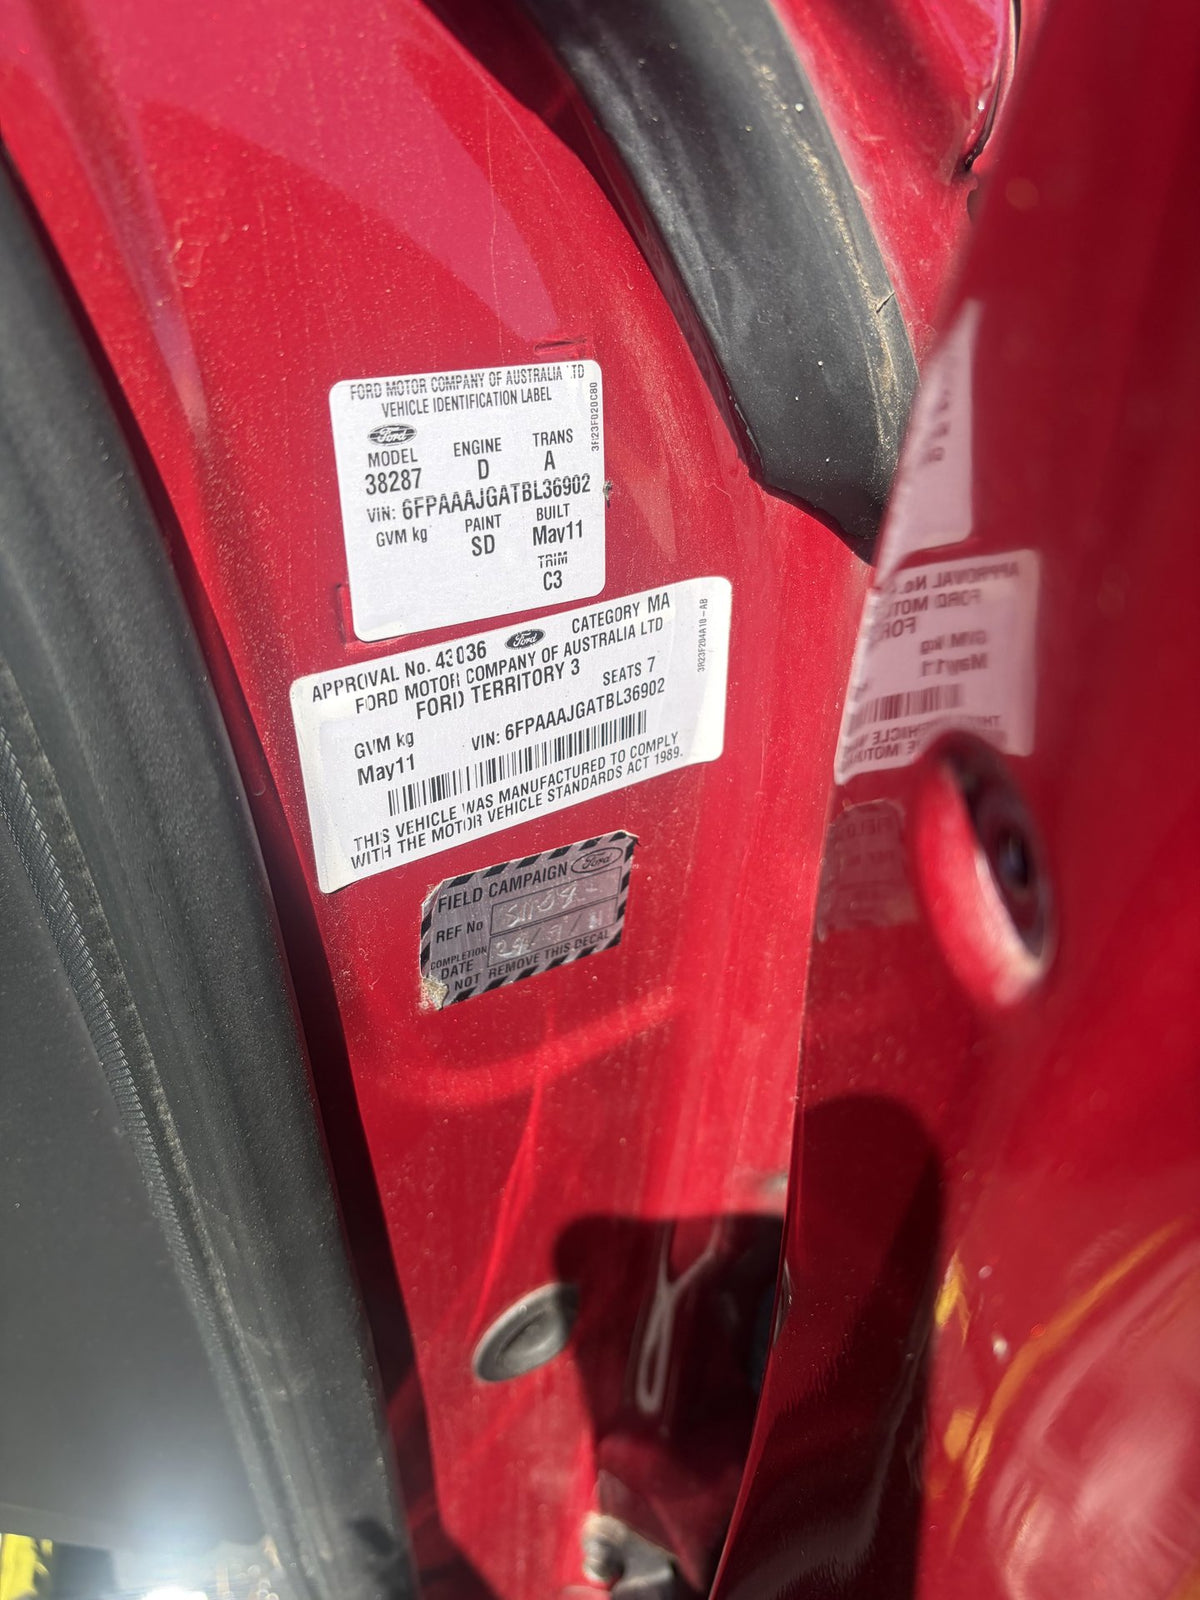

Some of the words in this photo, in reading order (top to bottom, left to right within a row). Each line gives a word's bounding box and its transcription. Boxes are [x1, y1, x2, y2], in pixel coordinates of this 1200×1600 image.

[350, 382, 382, 400] FORD
[386, 378, 427, 397] MOTOR
[431, 372, 484, 393] COMPANY
[489, 371, 502, 387] OF
[506, 365, 563, 386] AUSTRALIA
[566, 364, 585, 380] TD
[382, 398, 429, 418] VEHICLE
[433, 389, 518, 413] IDENTIFICATION
[521, 386, 552, 404] LABEL
[453, 437, 502, 457] ENGINE
[532, 428, 573, 447] TRANS
[368, 447, 418, 468] MODEL
[478, 458, 490, 480] D
[544, 450, 556, 471] A
[365, 467, 422, 496] 38287
[366, 506, 396, 523] VIN:
[402, 472, 591, 520] 6FPAAAJGATBL36902
[537, 503, 570, 521] BUILT
[376, 529, 407, 548] GVM
[412, 526, 428, 543] kg
[465, 514, 502, 533] PAINT
[471, 534, 495, 557] SD
[537, 551, 568, 568] TRIM
[543, 570, 563, 591] C3
[572, 601, 641, 634] CATEGORY
[647, 592, 670, 614] MA
[312, 666, 400, 703] APPROVAL
[405, 661, 431, 678] No.
[435, 640, 487, 669] 43036
[355, 688, 398, 714] FORD
[404, 672, 460, 702] MOTOR
[466, 651, 536, 684] COMPANY
[541, 645, 559, 663] OF
[564, 624, 636, 658] AUSTRALIA
[640, 617, 663, 636] LTD
[602, 662, 642, 686] SEATS
[647, 656, 656, 673] 7
[416, 690, 465, 720] FORD
[471, 661, 565, 704] TERRITORY
[571, 658, 580, 676] 3
[472, 731, 500, 751] VIN:
[505, 677, 665, 741] 6FPAAAJGATBL36902
[354, 735, 391, 760] GVM
[396, 731, 414, 748] kg
[357, 753, 415, 786] May11
[354, 828, 390, 852] THIS
[396, 805, 457, 838] VEHICLE
[462, 793, 494, 815] WAS
[499, 756, 606, 804] MANUFACTURED
[610, 749, 626, 765] TO
[630, 731, 679, 759] COMPLY
[351, 844, 391, 870] WITH
[398, 833, 426, 854] THE
[431, 813, 482, 843] MOTOR
[487, 792, 542, 823] VEHICLE
[547, 765, 622, 803] STANDARDS
[627, 756, 650, 776] ACT
[655, 746, 683, 765] 1989.
[437, 887, 483, 913] FIELD
[489, 861, 568, 899] CAMPAIGN
[436, 924, 462, 944] REF
[466, 921, 484, 934] No
[430, 945, 487, 970] COMPLETION
[441, 959, 474, 980] DATE
[454, 973, 480, 991] NOT
[488, 953, 540, 979] REMOVE
[545, 943, 571, 962] THIS
[574, 930, 609, 949] DECAL
